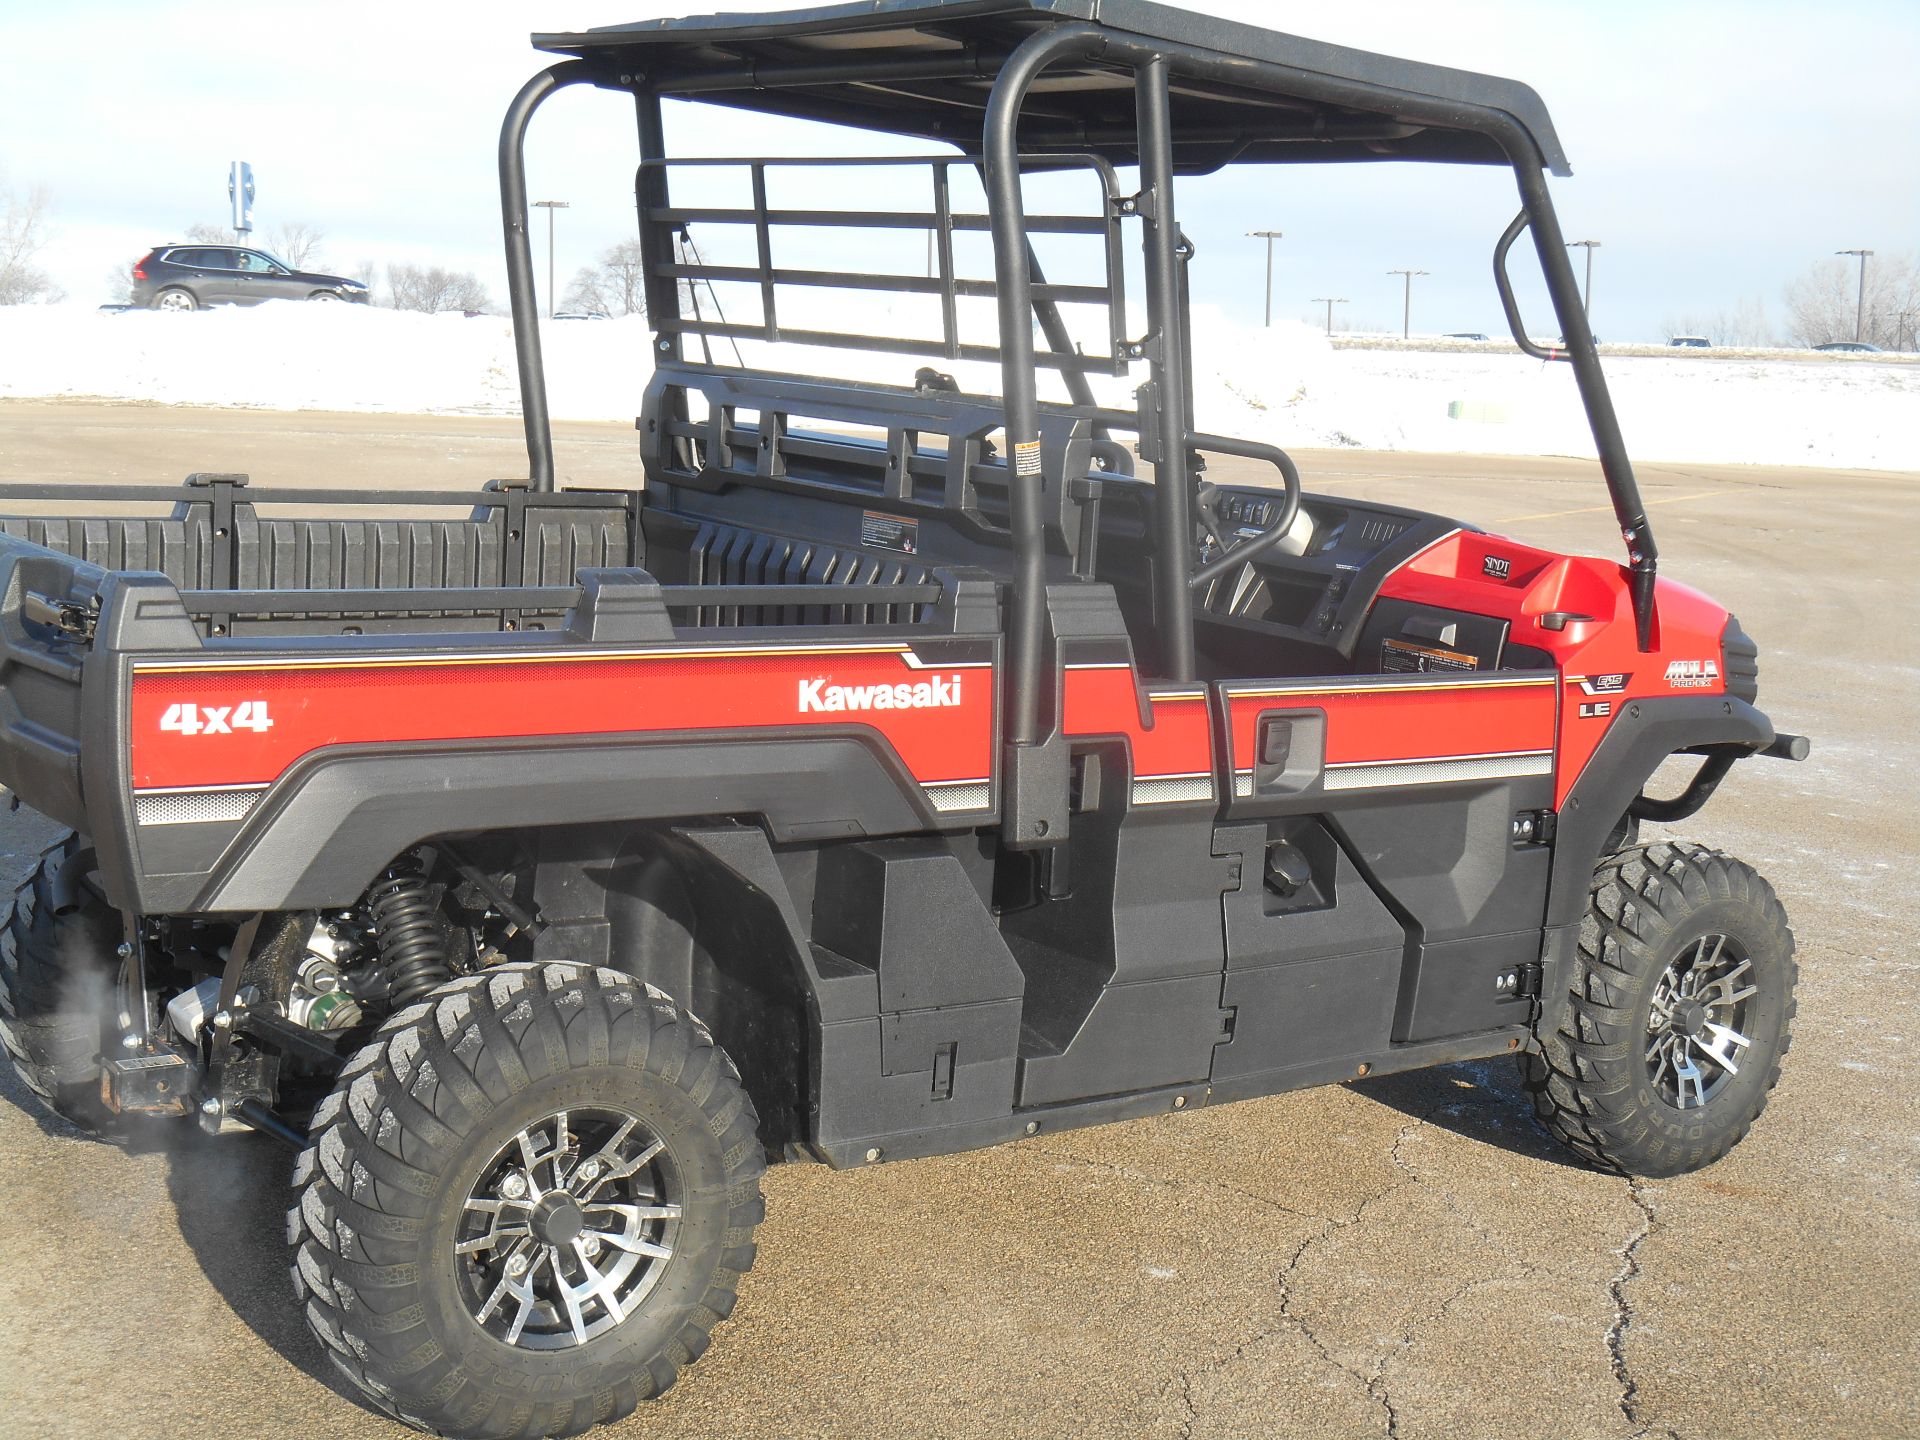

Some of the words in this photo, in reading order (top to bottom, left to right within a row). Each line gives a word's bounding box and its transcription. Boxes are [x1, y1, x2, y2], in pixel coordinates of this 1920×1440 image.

[799, 675, 961, 712] Kawasaki
[1579, 702, 1611, 717] LE
[160, 700, 274, 735] 4x4
